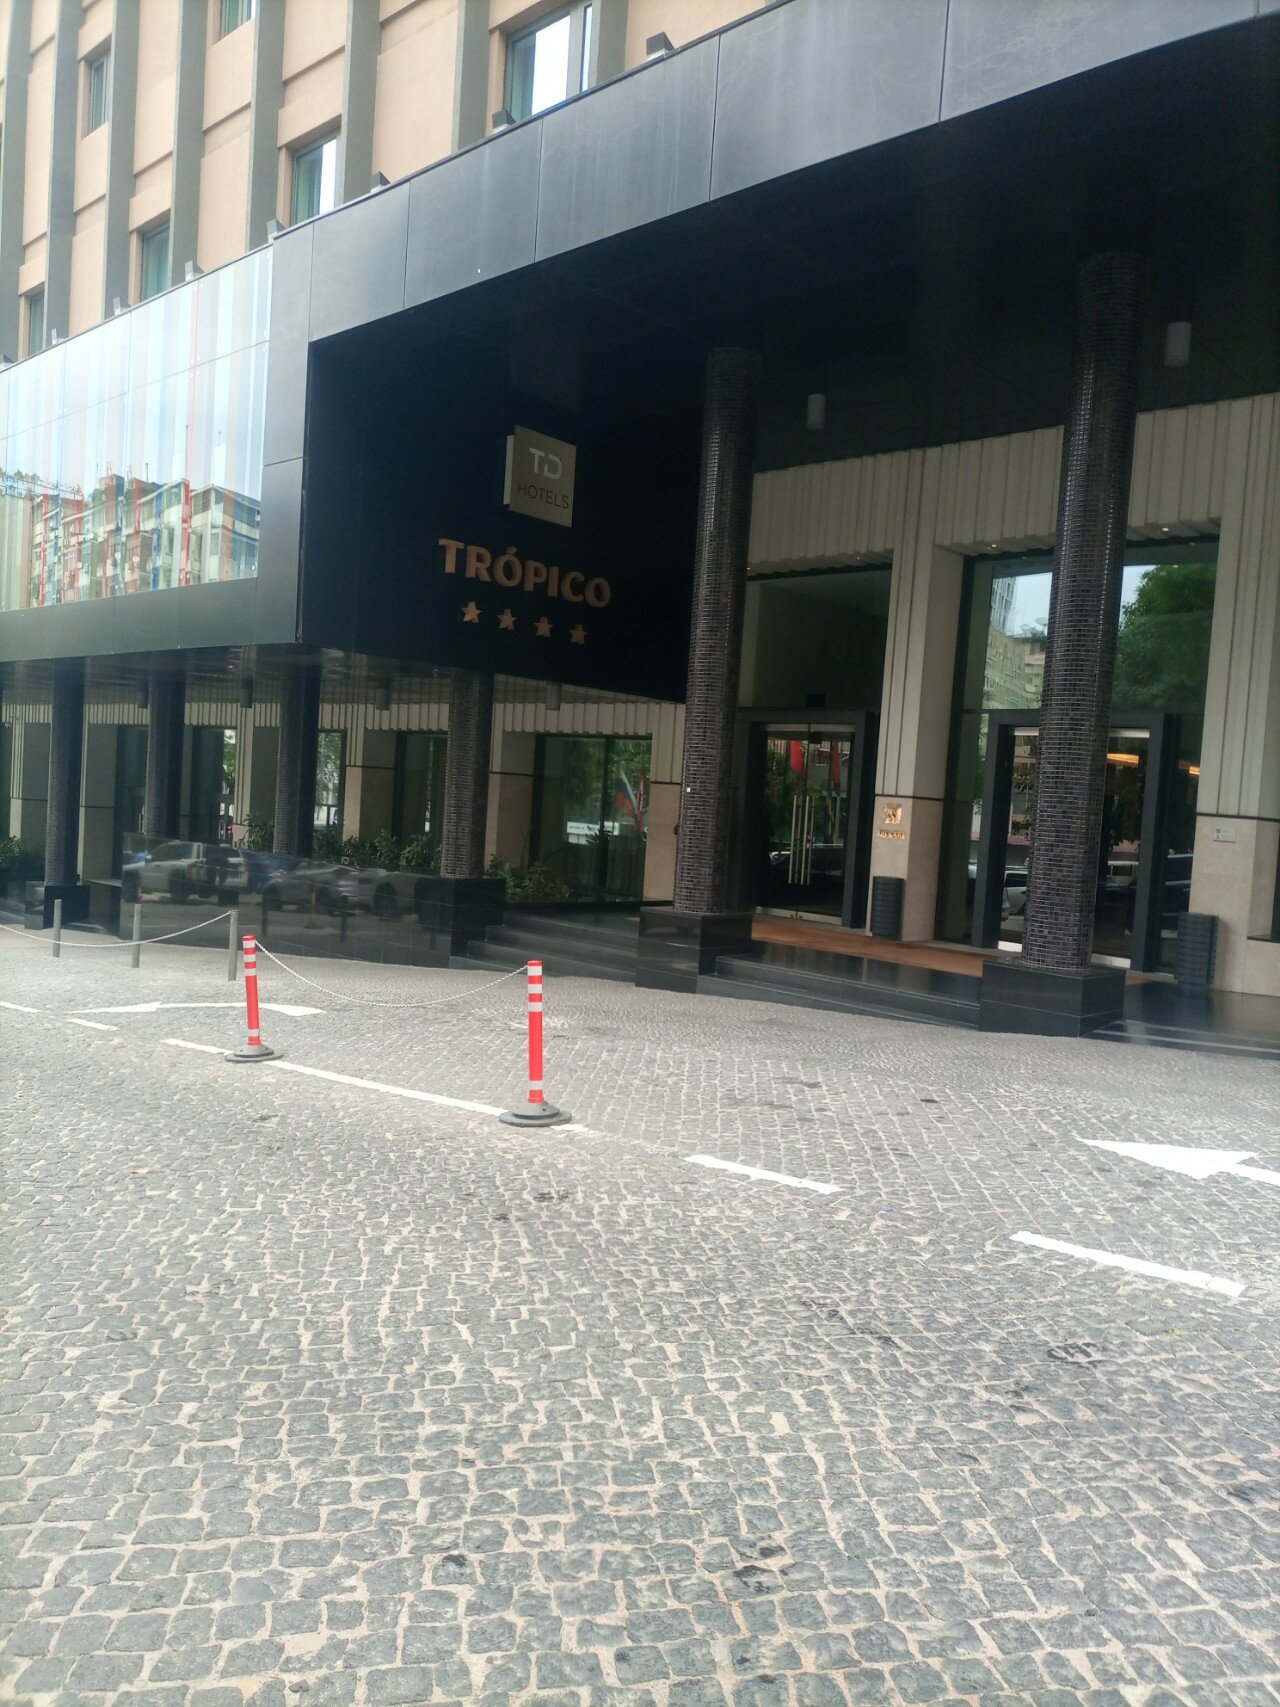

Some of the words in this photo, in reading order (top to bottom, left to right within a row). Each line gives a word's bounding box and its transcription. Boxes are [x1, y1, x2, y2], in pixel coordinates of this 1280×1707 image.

[529, 447, 563, 480] TD
[517, 484, 569, 510] HOTELS
[438, 538, 612, 608] TRÓPICO
